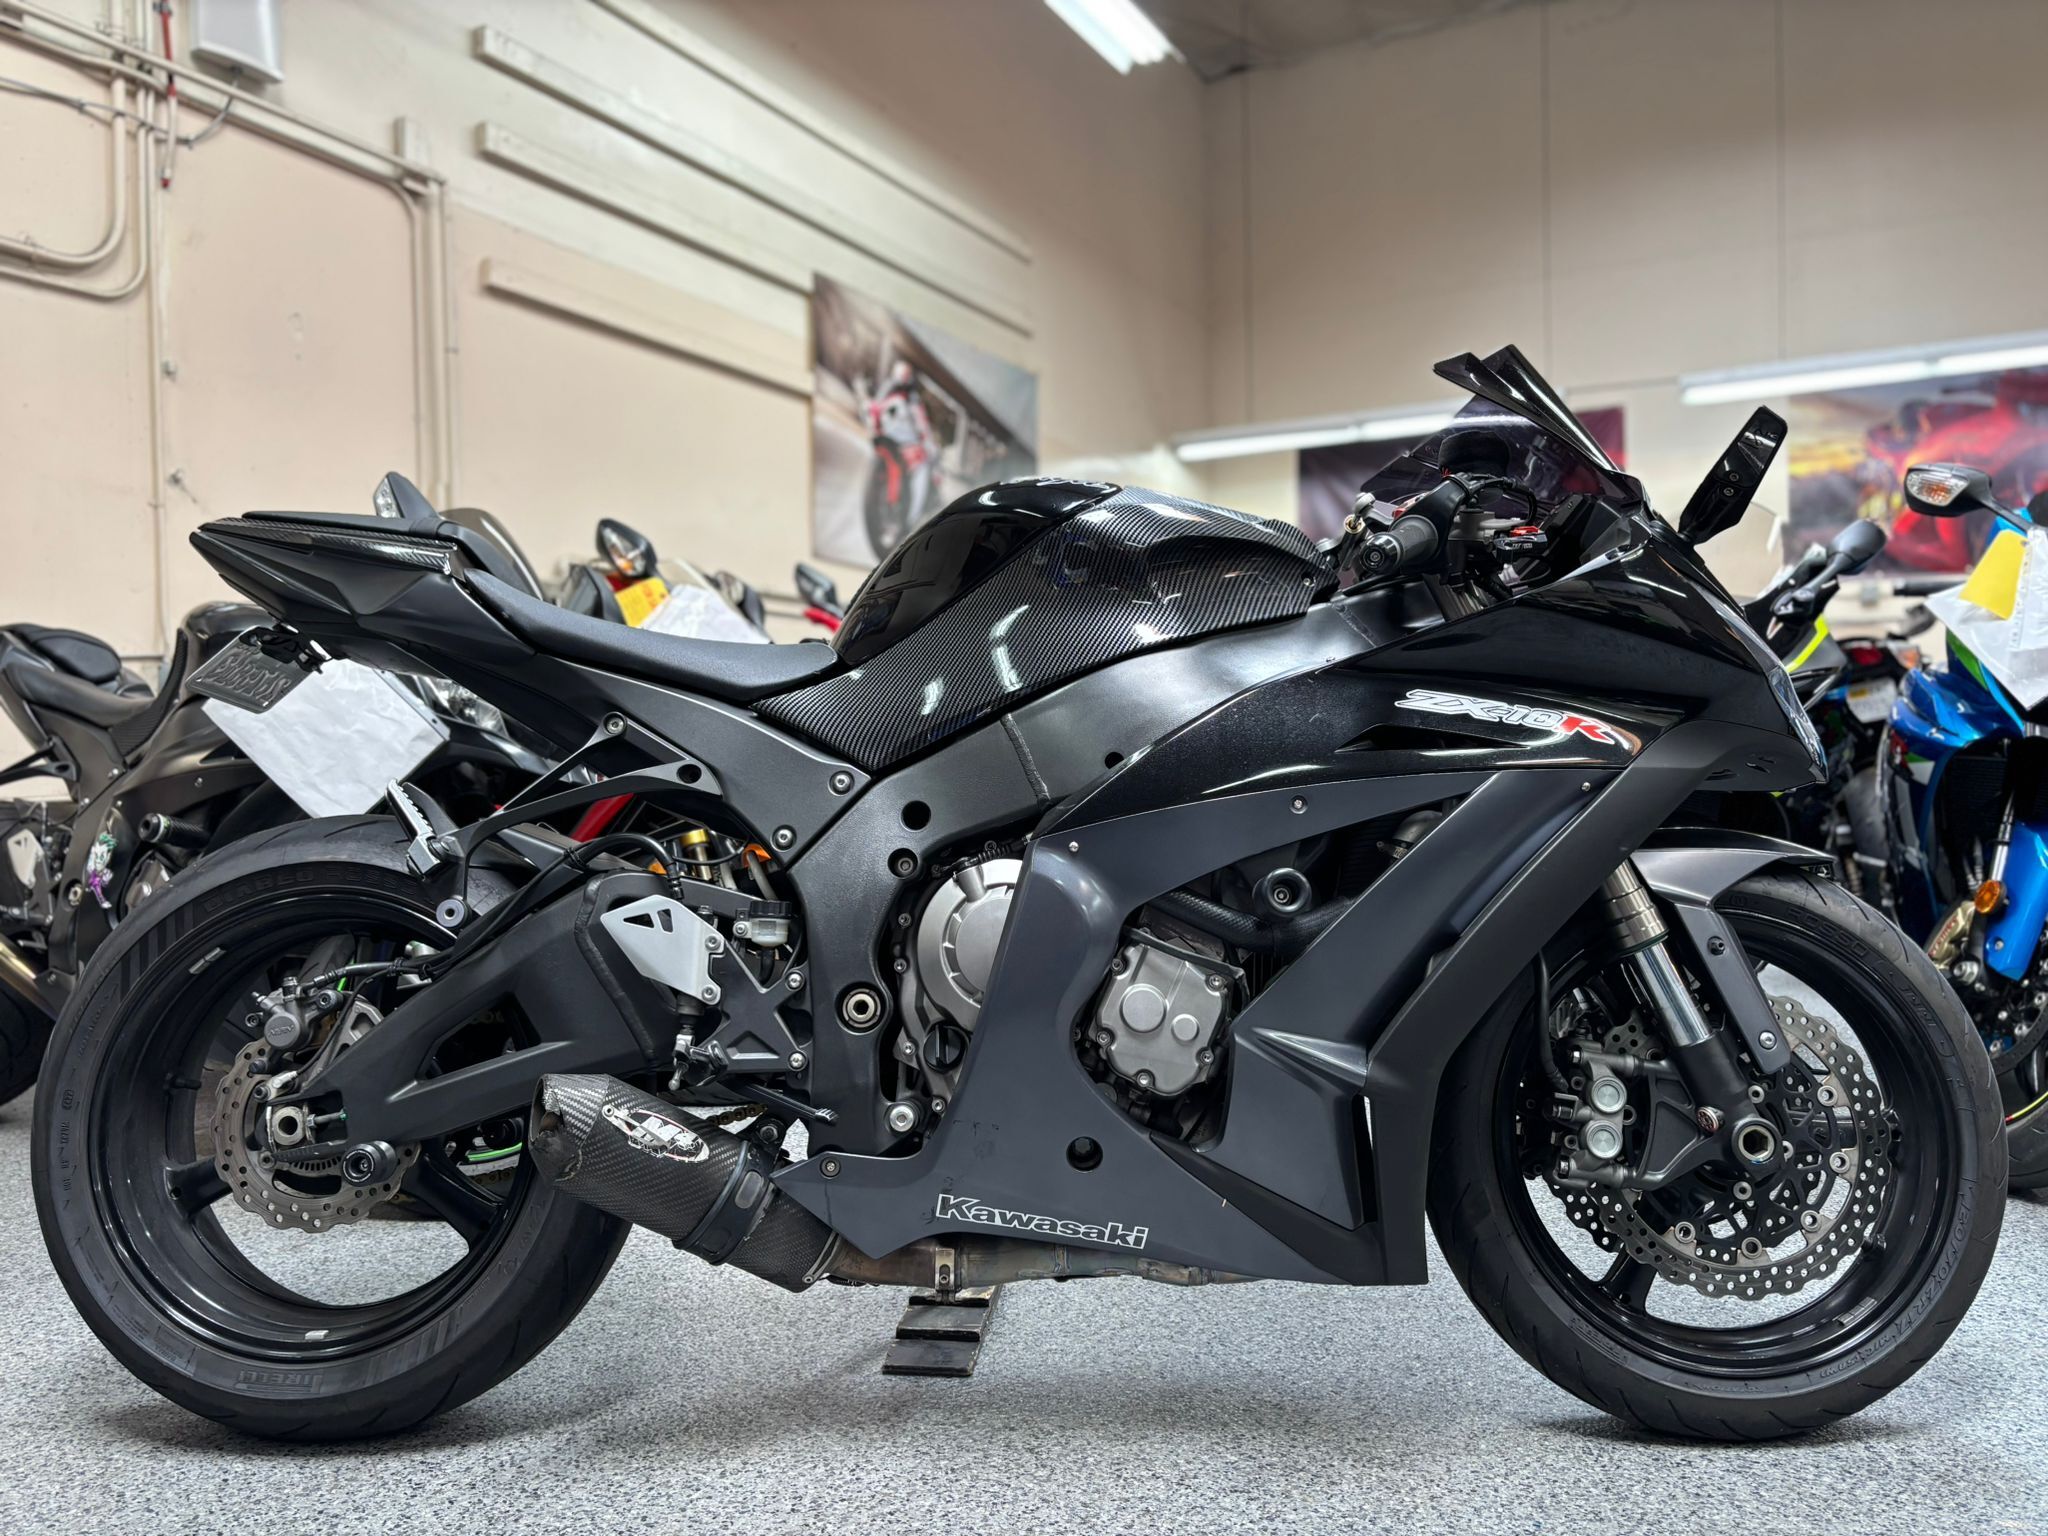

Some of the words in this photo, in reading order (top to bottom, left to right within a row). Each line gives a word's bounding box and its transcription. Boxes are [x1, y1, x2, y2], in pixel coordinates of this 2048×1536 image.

[1394, 689, 1616, 745] ZX-10R
[935, 1193, 1150, 1250] Kawasaki
[237, 1366, 324, 1398] PIRELLI
